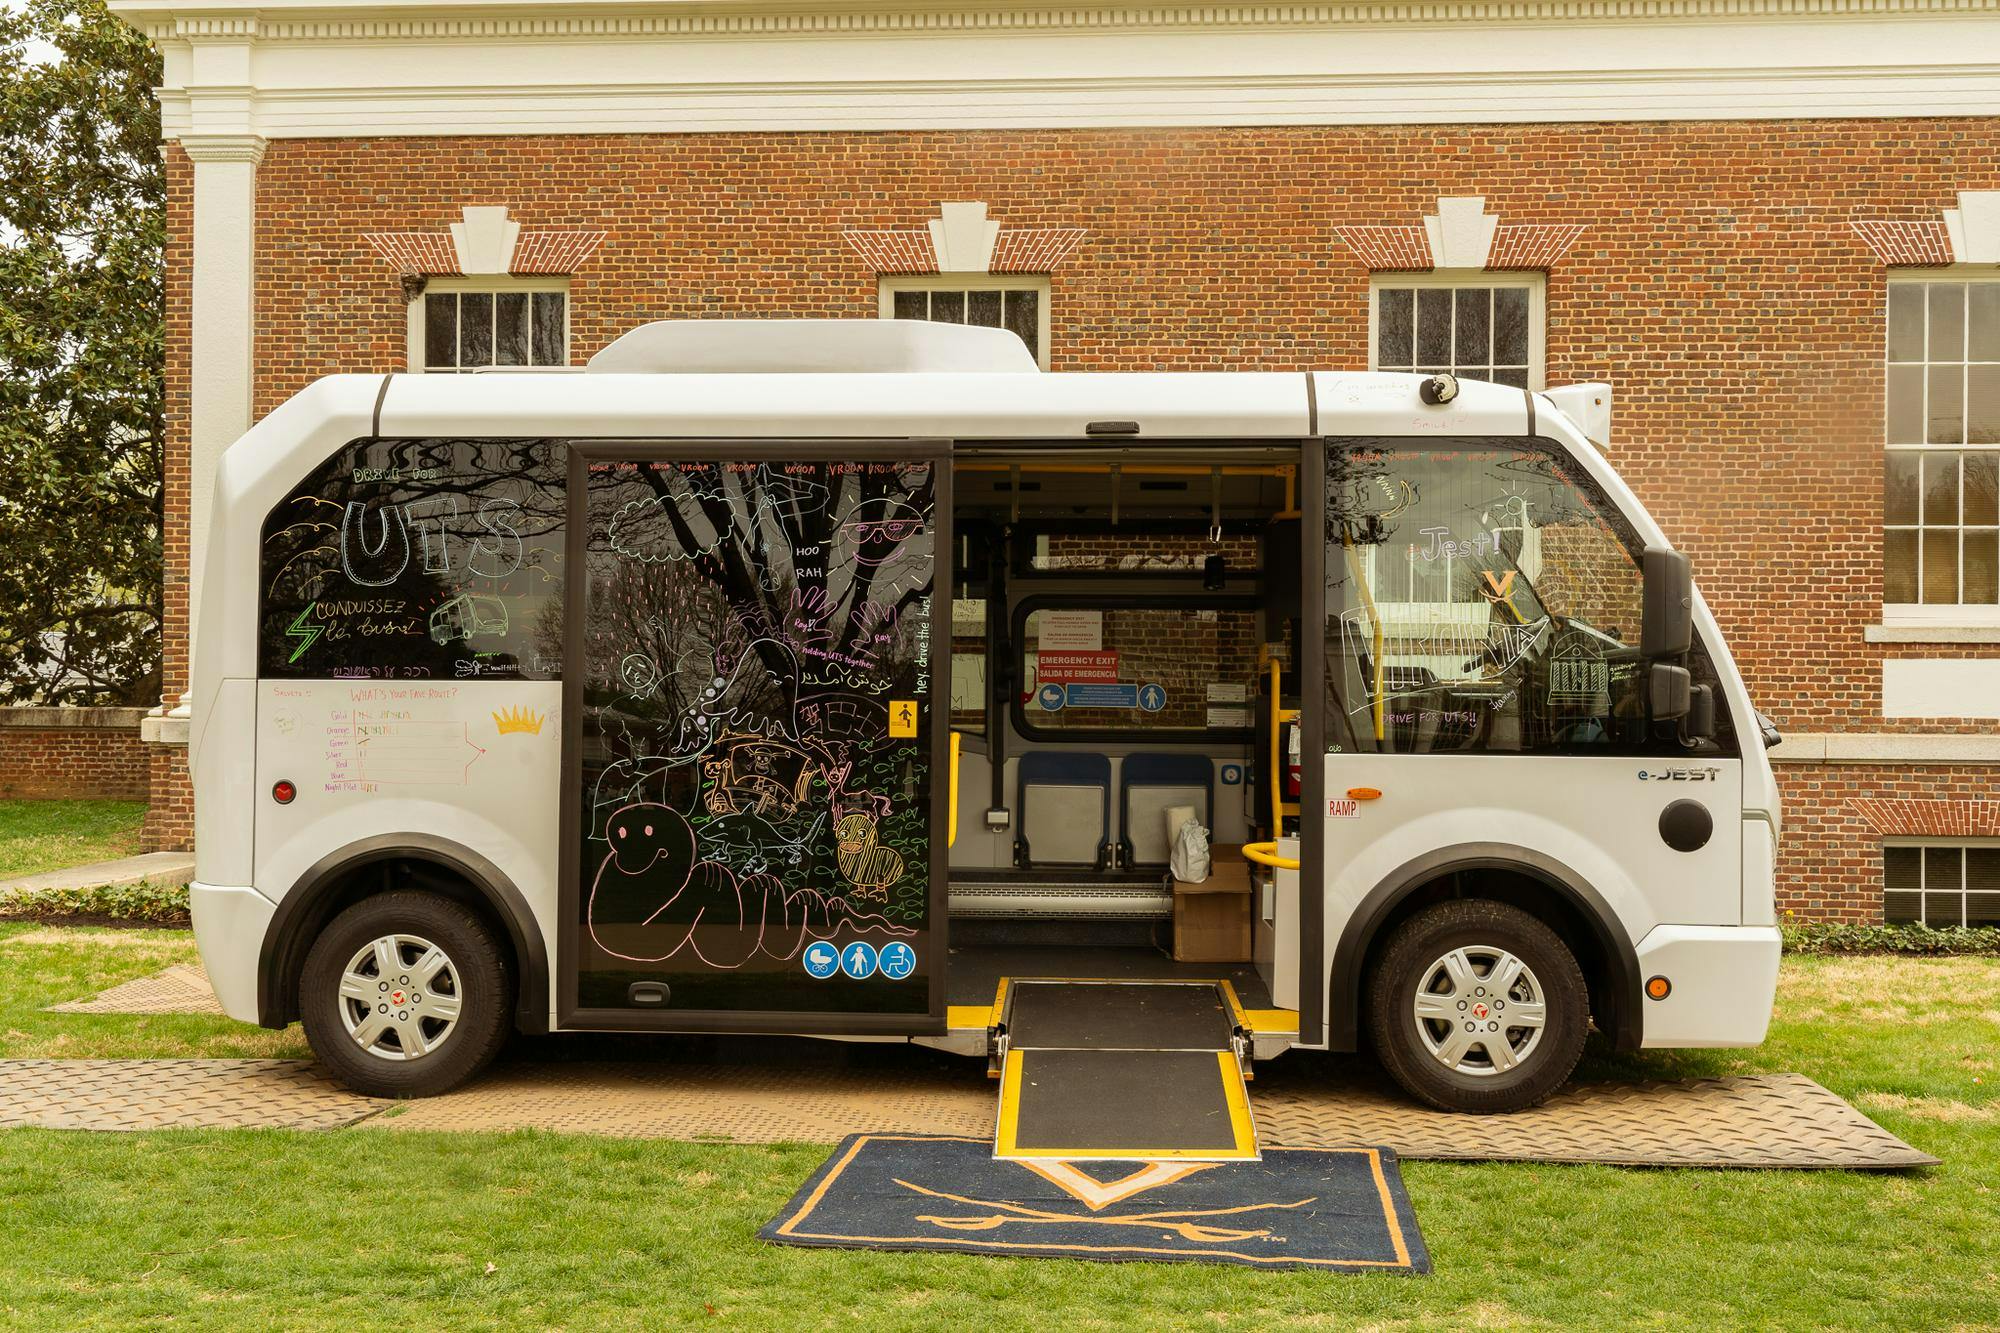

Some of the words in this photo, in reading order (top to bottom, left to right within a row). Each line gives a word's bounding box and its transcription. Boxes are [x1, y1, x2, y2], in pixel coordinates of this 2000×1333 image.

[353, 469, 400, 483] DRIVE
[413, 468, 436, 480] FOR
[681, 463, 709, 472] VROOM
[726, 463, 757, 472] VROOM
[784, 464, 815, 474] VROOM
[829, 463, 865, 476] VROOM
[341, 498, 522, 587] UTS
[796, 546, 820, 556] HOO
[796, 568, 823, 579] RAH
[316, 599, 407, 620] CONDUISSEZ
[916, 622, 930, 640] the
[828, 651, 844, 661] UTS
[914, 640, 929, 668] drive
[1040, 656, 1094, 664] EMERGENCY
[1096, 657, 1117, 665] EXIT
[1040, 669, 1062, 677] SALIDA
[1074, 670, 1117, 678] EMERGENCIA
[350, 687, 387, 702] WHAT'S
[1383, 713, 1413, 724] DRIVE
[1420, 712, 1439, 721] FOR
[1638, 767, 1722, 781] e-JEST
[1329, 801, 1357, 816] RAMP
